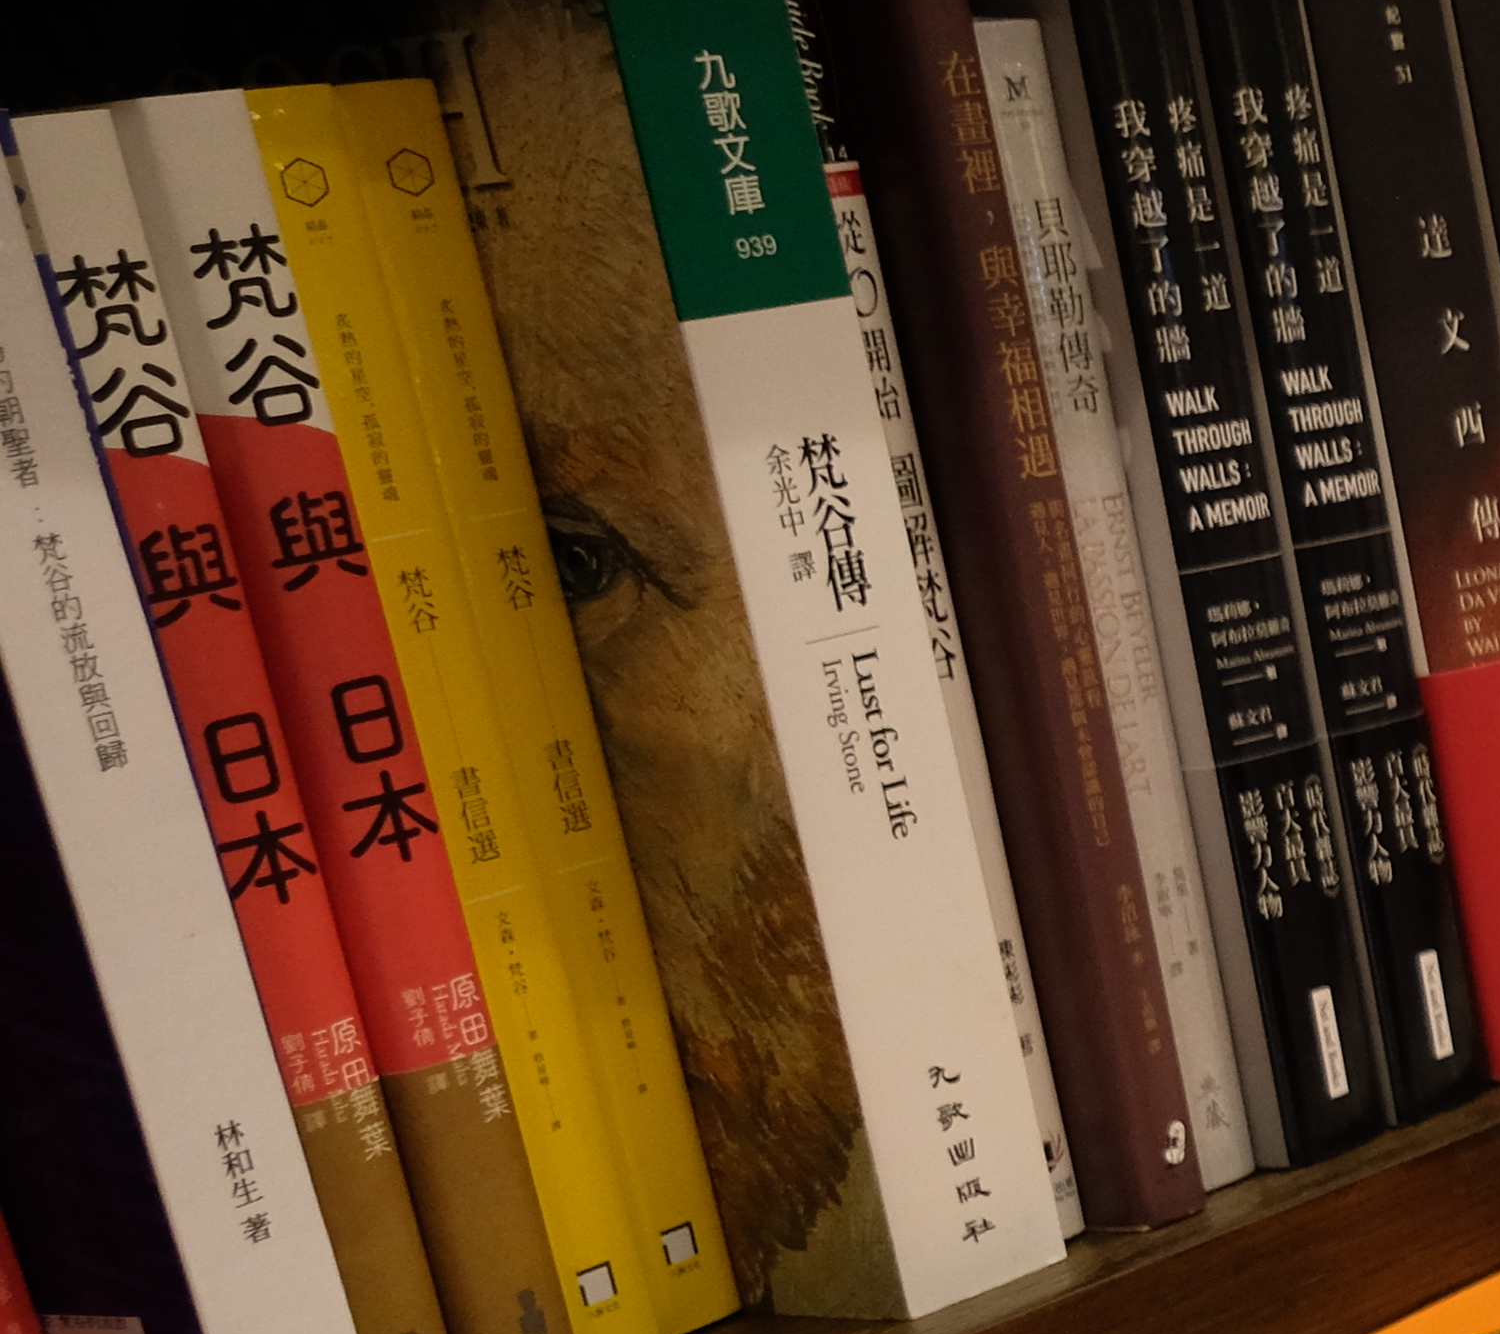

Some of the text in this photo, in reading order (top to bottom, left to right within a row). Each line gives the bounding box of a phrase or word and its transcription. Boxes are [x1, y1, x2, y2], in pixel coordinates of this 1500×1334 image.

[694, 49, 767, 216] 九歌文庫
[1166, 94, 1233, 314] 疼痛是一道
[1285, 83, 1346, 295] 疼痛是一道
[735, 233, 778, 260] 939
[1112, 97, 1193, 364] 我穿越了的牆
[1232, 85, 1308, 345] 我穿越了的牆
[1033, 197, 1101, 416] 貝耶勒傳奇
[1165, 386, 1220, 419] WALK
[1172, 419, 1254, 456] THROUGH
[1280, 366, 1333, 398] WALK
[1287, 397, 1364, 433] THROUGH
[190, 221, 439, 864] 梵谷與日本
[764, 443, 817, 584] 余光中 譯
[797, 434, 873, 613] 梵谷傳
[1187, 493, 1272, 533] A MEMOIR
[1304, 470, 1382, 508] A MEMOIR
[60, 247, 318, 907] 梵谷與日本
[1460, 588, 1487, 611] DA
[1463, 614, 1485, 635] BY
[398, 565, 501, 865] 梵谷 書信選
[495, 544, 593, 838] 梵谷 書信選
[820, 657, 868, 797] Irving Stone
[851, 647, 886, 717] Lust
[878, 774, 917, 841] Life
[1237, 787, 1285, 921] 影響力人物
[1348, 757, 1394, 888] 影響力人物
[330, 1016, 392, 1163] 原田舞葉
[449, 971, 512, 1124] 原田舞葉
[214, 1120, 274, 1246] 林和生 著
[929, 1064, 998, 1247] 九歌出版社
